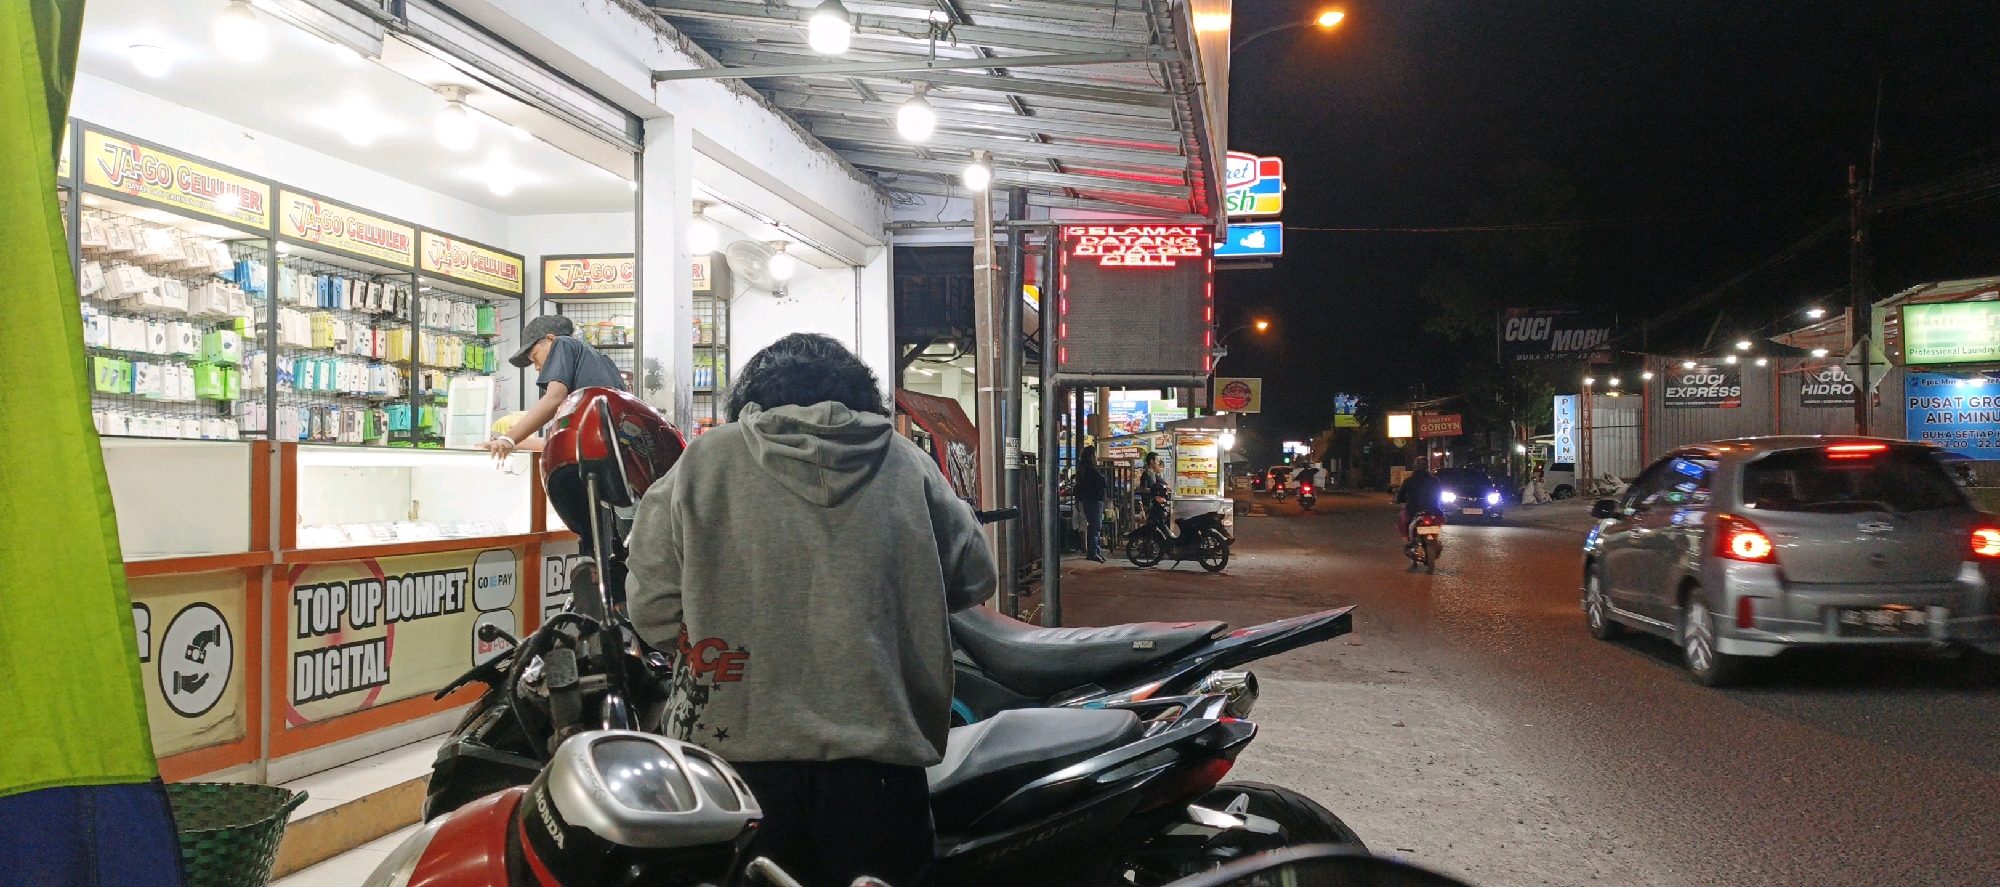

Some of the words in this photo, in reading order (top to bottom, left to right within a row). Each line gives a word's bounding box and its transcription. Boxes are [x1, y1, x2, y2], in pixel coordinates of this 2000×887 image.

[98, 143, 173, 187] JA-GO
[288, 200, 343, 236] JA-GO
[346, 216, 410, 254] CELLULER
[1067, 226, 1203, 236] SELAMAT
[1079, 236, 1198, 247] DATANG
[428, 239, 469, 270] JA-GO
[470, 250, 519, 281] CELLULER
[1100, 254, 1176, 266] CELL
[555, 263, 617, 290] JA-GO
[1918, 312, 2000, 329] Laundr
[1505, 317, 1552, 341] CUCI
[1910, 347, 1960, 356] Professional
[1962, 346, 1995, 355] Laundry
[1682, 374, 1725, 385] CUCI
[1921, 379, 1938, 387] Epic
[1665, 386, 1741, 398] EXPRESS
[1909, 396, 1964, 409] PUSAT
[1926, 412, 1954, 423] AIR
[1421, 422, 1460, 431] GORDYN
[1561, 398, 1570, 454] PLAFON
[1922, 431, 1952, 439] BUKA
[1955, 430, 1994, 438] SETIAP
[477, 577, 489, 589] GO
[498, 573, 513, 586] PAY
[546, 554, 580, 597] BA
[295, 582, 346, 639] TOP
[348, 576, 385, 629] UP
[383, 567, 469, 625] DOMPET
[294, 638, 390, 706] DIGITAL
[535, 787, 565, 850] HONDA
